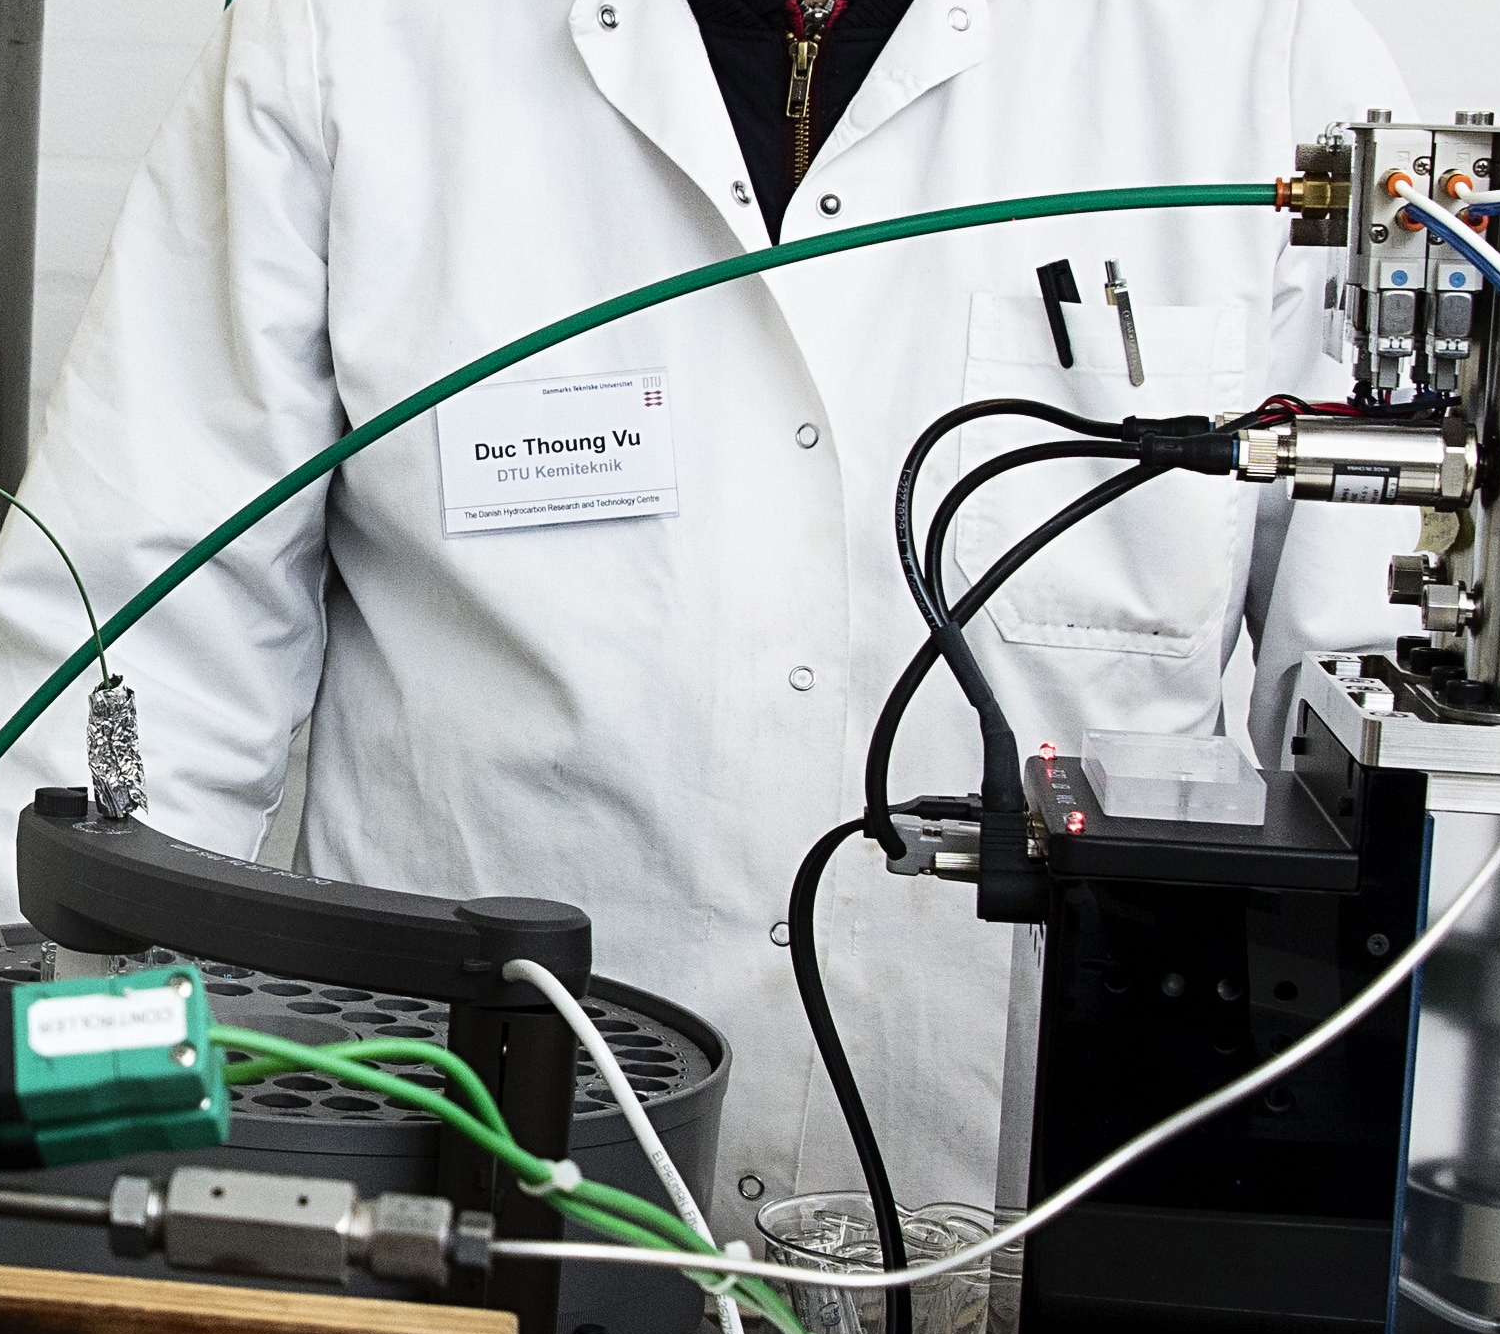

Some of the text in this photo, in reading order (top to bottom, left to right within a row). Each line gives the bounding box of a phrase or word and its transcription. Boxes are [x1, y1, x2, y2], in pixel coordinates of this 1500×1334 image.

[542, 381, 633, 396] Danmarks Tekniske Universitet
[642, 376, 662, 389] DTU
[475, 429, 641, 461] Duc Thoung Vu
[496, 459, 622, 482] DTU Kemiteknik
[464, 494, 660, 520] The Danish Hydrocarbon Research and Technology Centre
